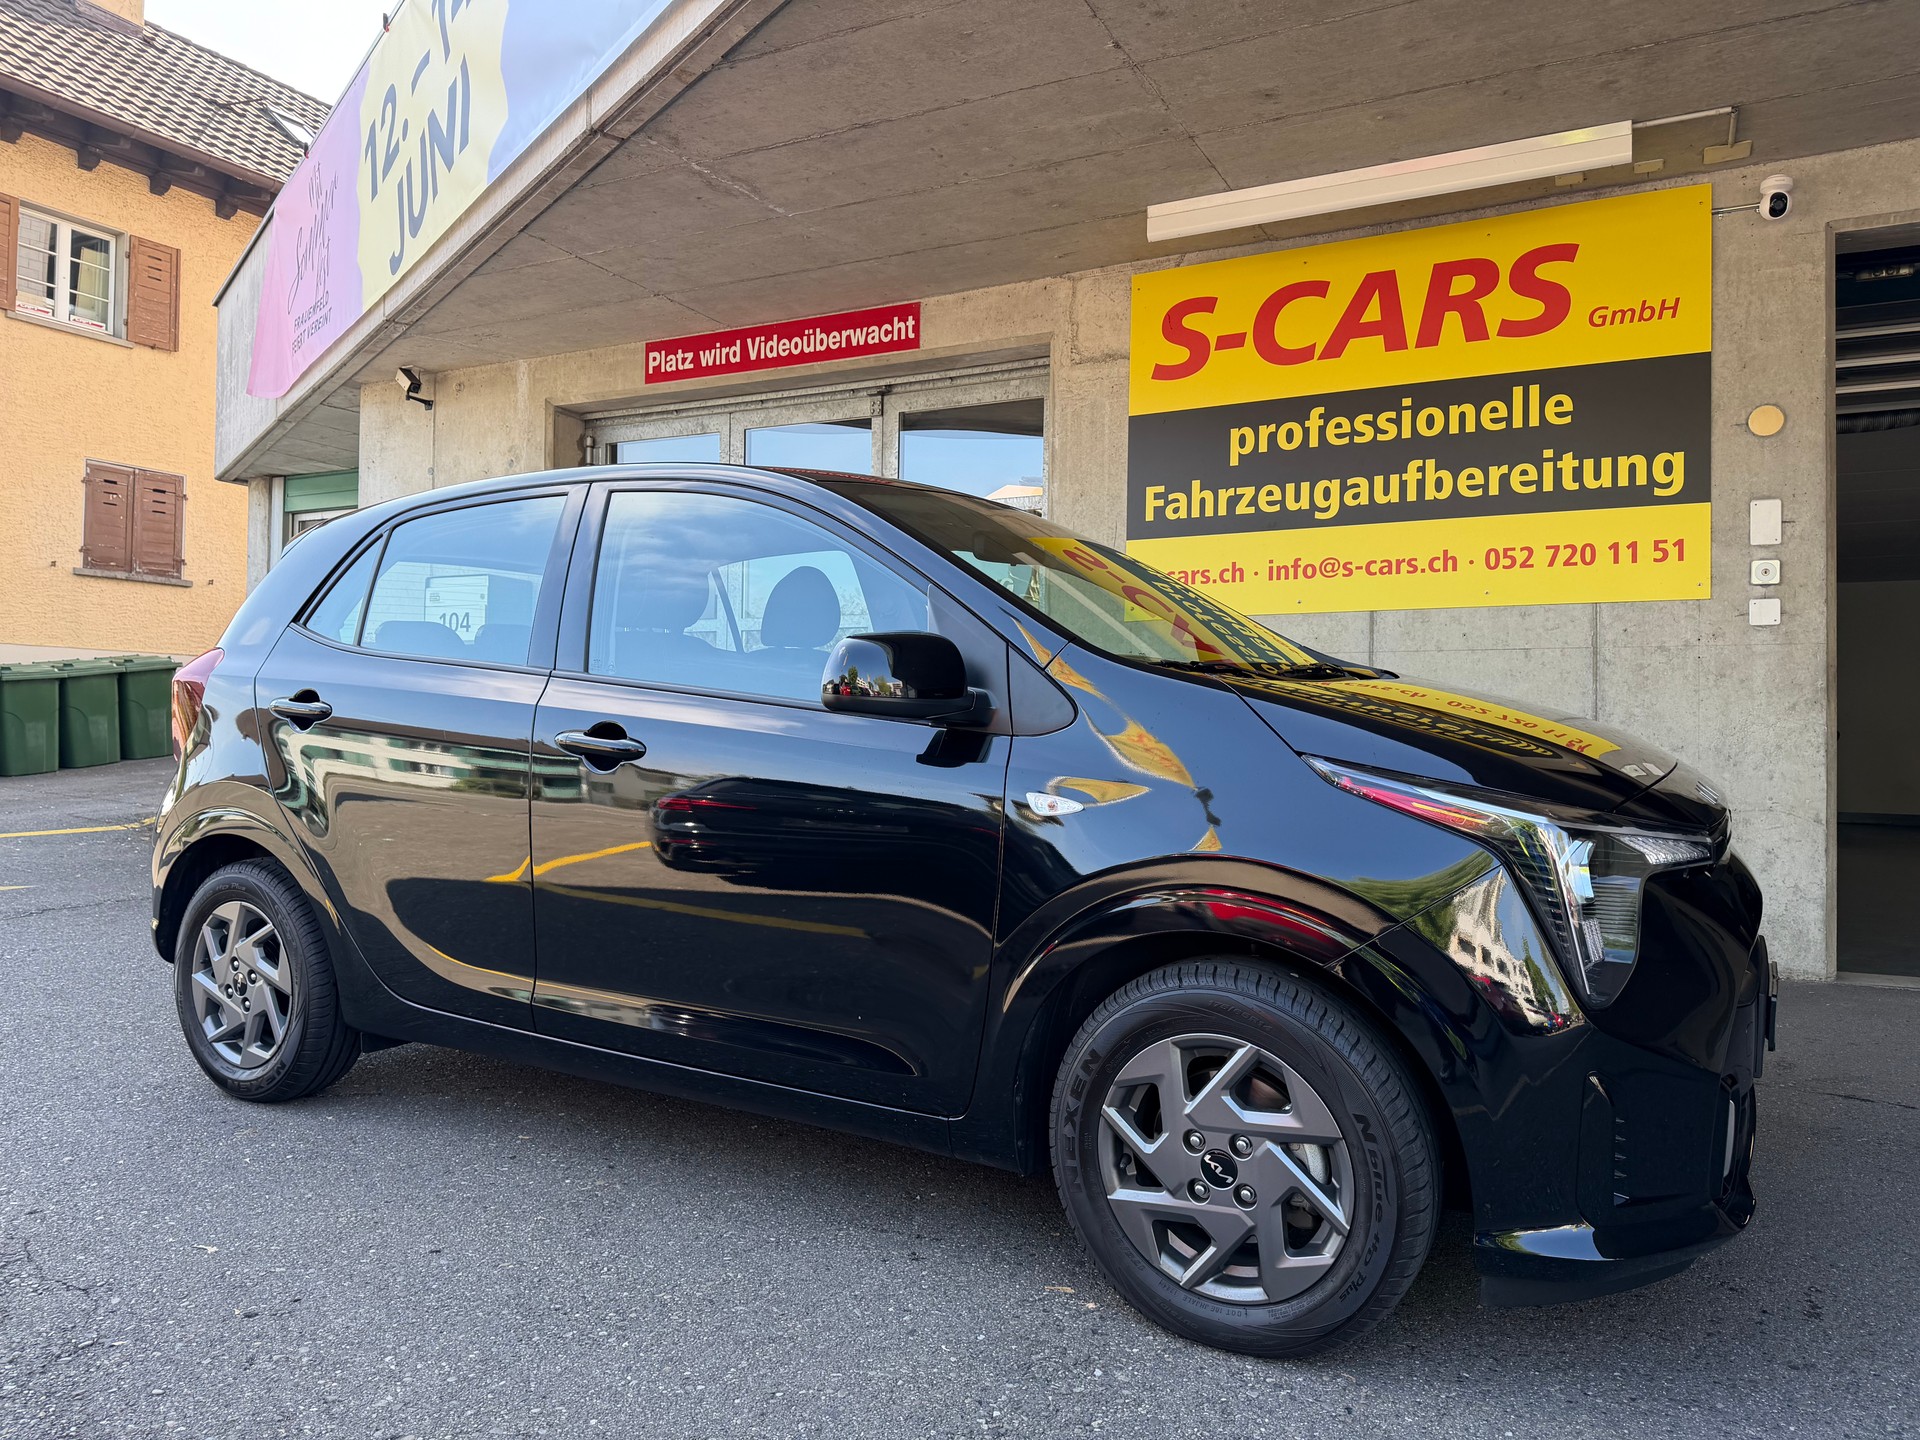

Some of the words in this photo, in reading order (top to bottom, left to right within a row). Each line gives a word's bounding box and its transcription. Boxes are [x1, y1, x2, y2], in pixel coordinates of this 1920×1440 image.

[389, 52, 471, 276] JUNI
[293, 289, 330, 334] FRAUENFELD
[307, 306, 333, 340] VEREINT
[1152, 243, 1580, 382] S-CARS
[1588, 297, 1681, 328] GmbH
[648, 350, 694, 375] Platz
[699, 340, 741, 367] wird
[746, 315, 916, 361] Videoüberwacht
[1229, 383, 1574, 467] professionelle
[1145, 449, 1686, 522] Fahrzeugaufbereitung
[1268, 549, 1458, 581] info@s-cars.ch
[1484, 546, 1534, 571] 052
[1545, 543, 1597, 568] 720
[1607, 541, 1639, 565] 11
[1653, 538, 1686, 563] 51
[439, 612, 471, 633] 104
[1063, 1048, 1102, 1193] NEXEN
[1339, 1270, 1367, 1303] Plus
